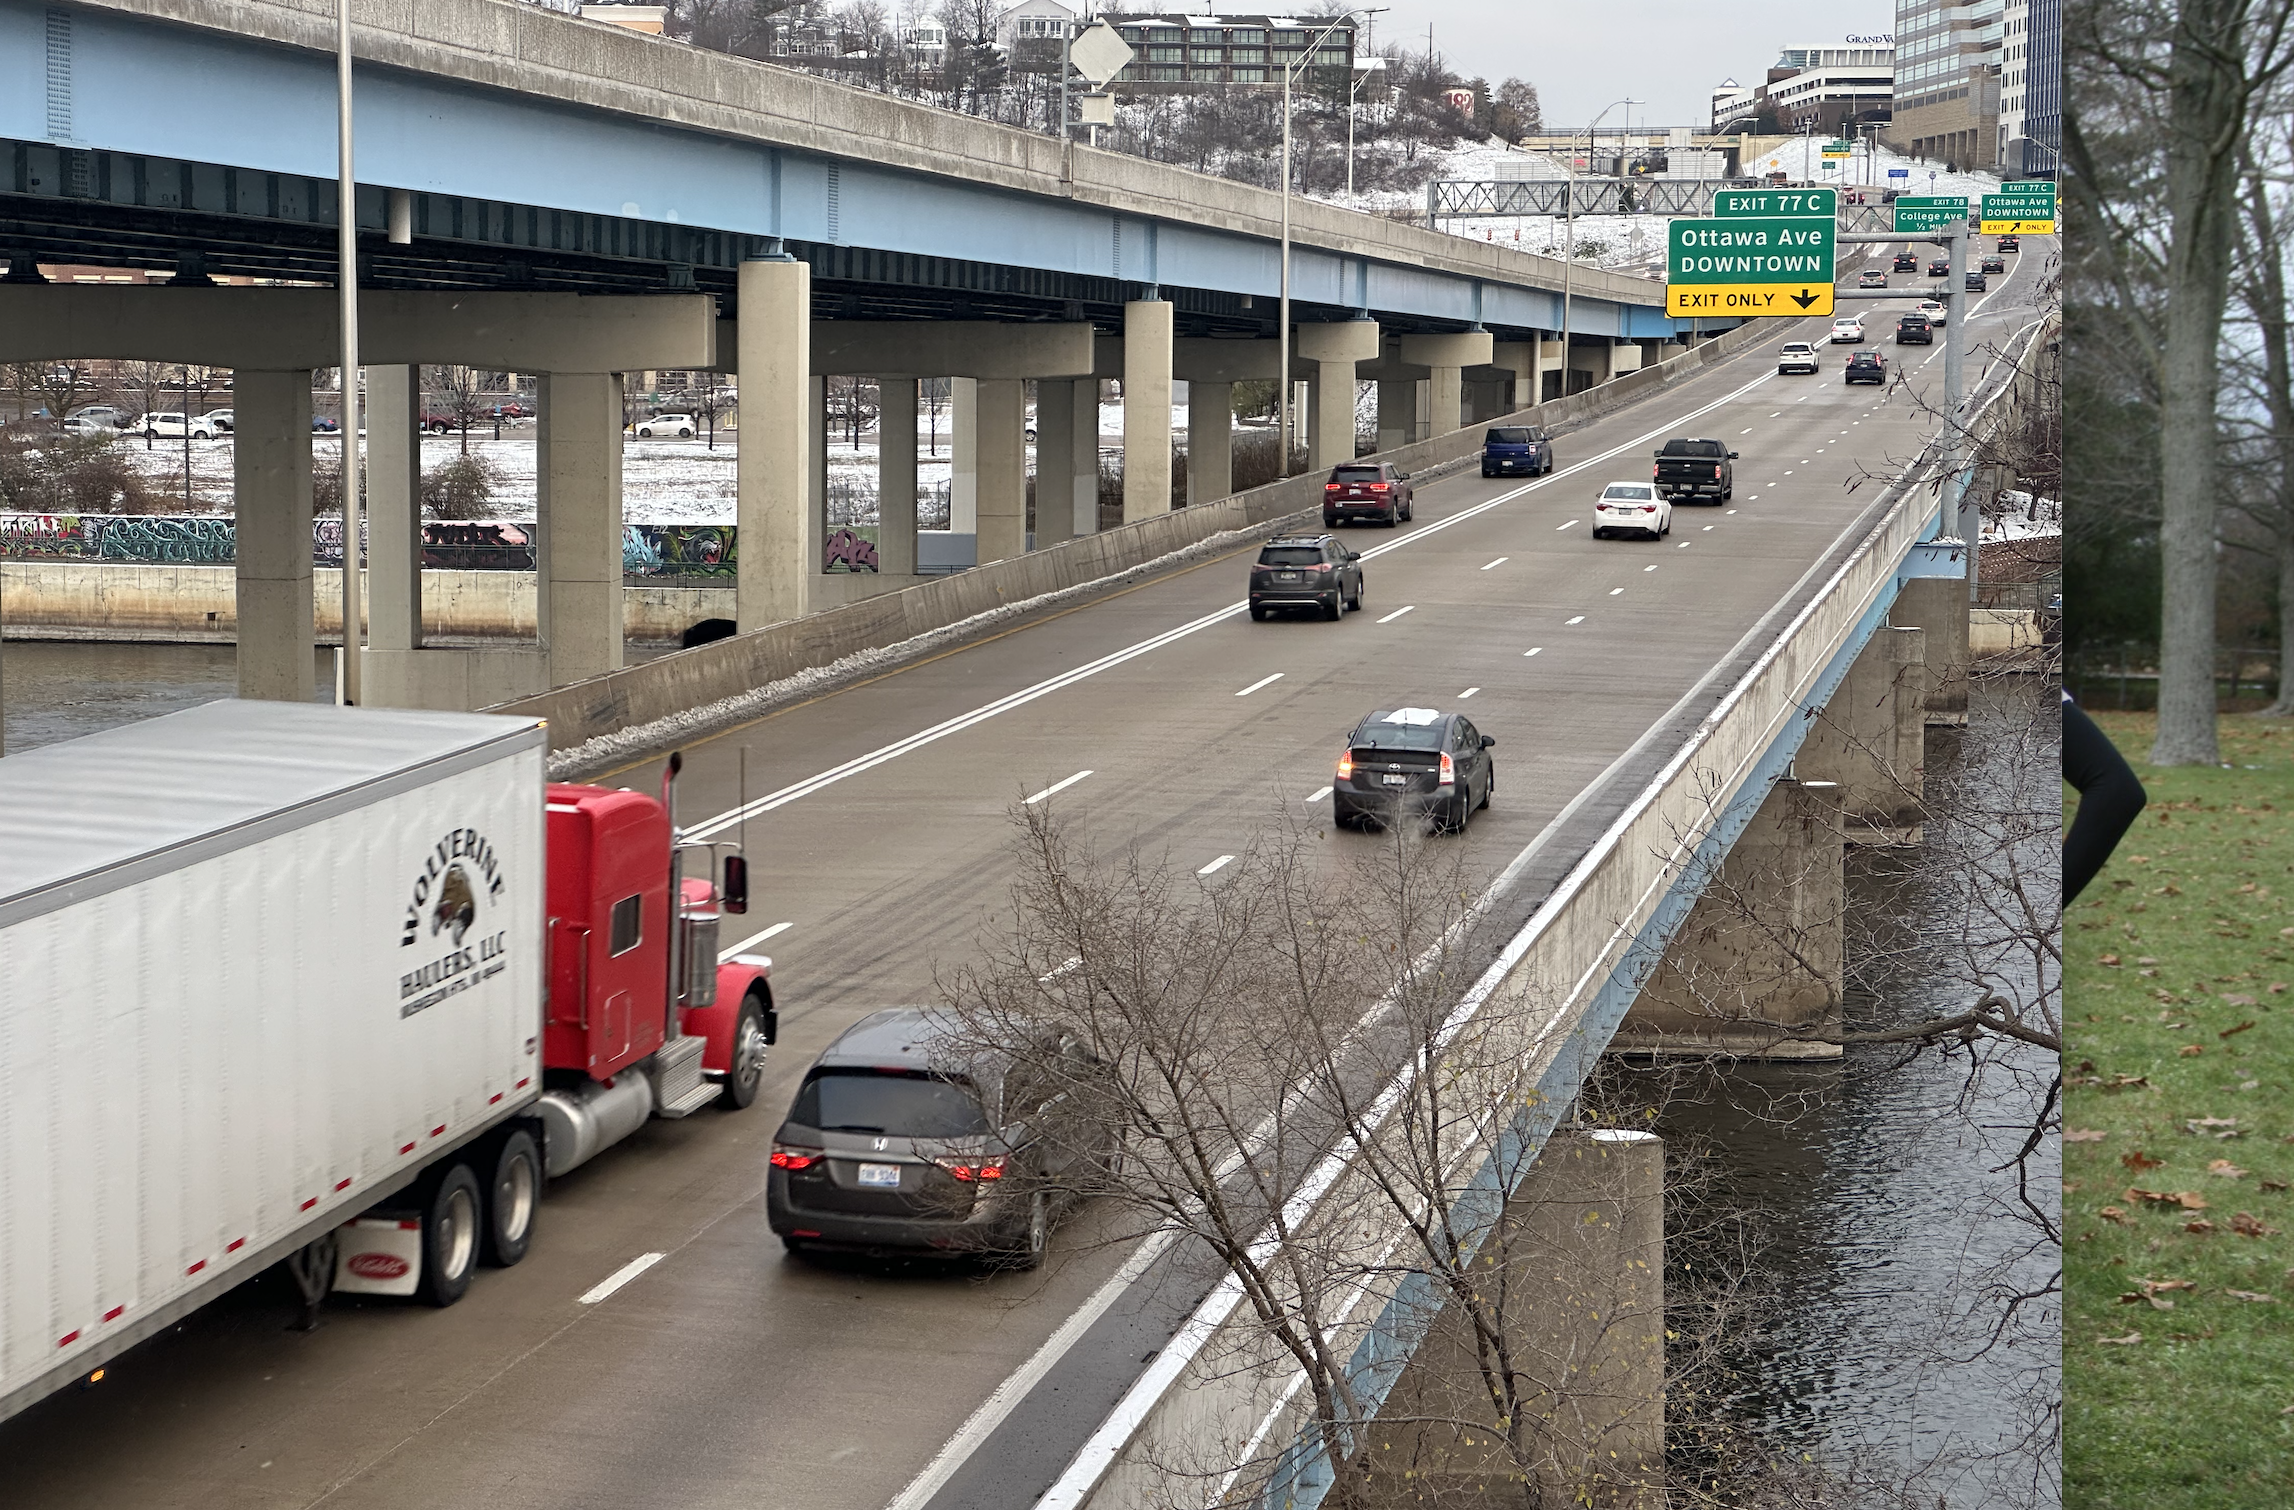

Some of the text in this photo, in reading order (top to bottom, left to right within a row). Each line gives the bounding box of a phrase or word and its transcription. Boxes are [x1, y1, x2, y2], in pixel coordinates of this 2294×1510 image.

[1729, 197, 1768, 211] EXIT
[1953, 198, 1965, 206] 78
[1988, 198, 2048, 206] Ottawa Ave
[1900, 212, 1963, 222] College Ave
[1987, 208, 2049, 217] DOWNTOWN
[1681, 228, 1822, 247] Ottawa Ave
[1681, 255, 1821, 273] DOWNTOWN
[1679, 293, 1776, 307] EXIT ONLY
